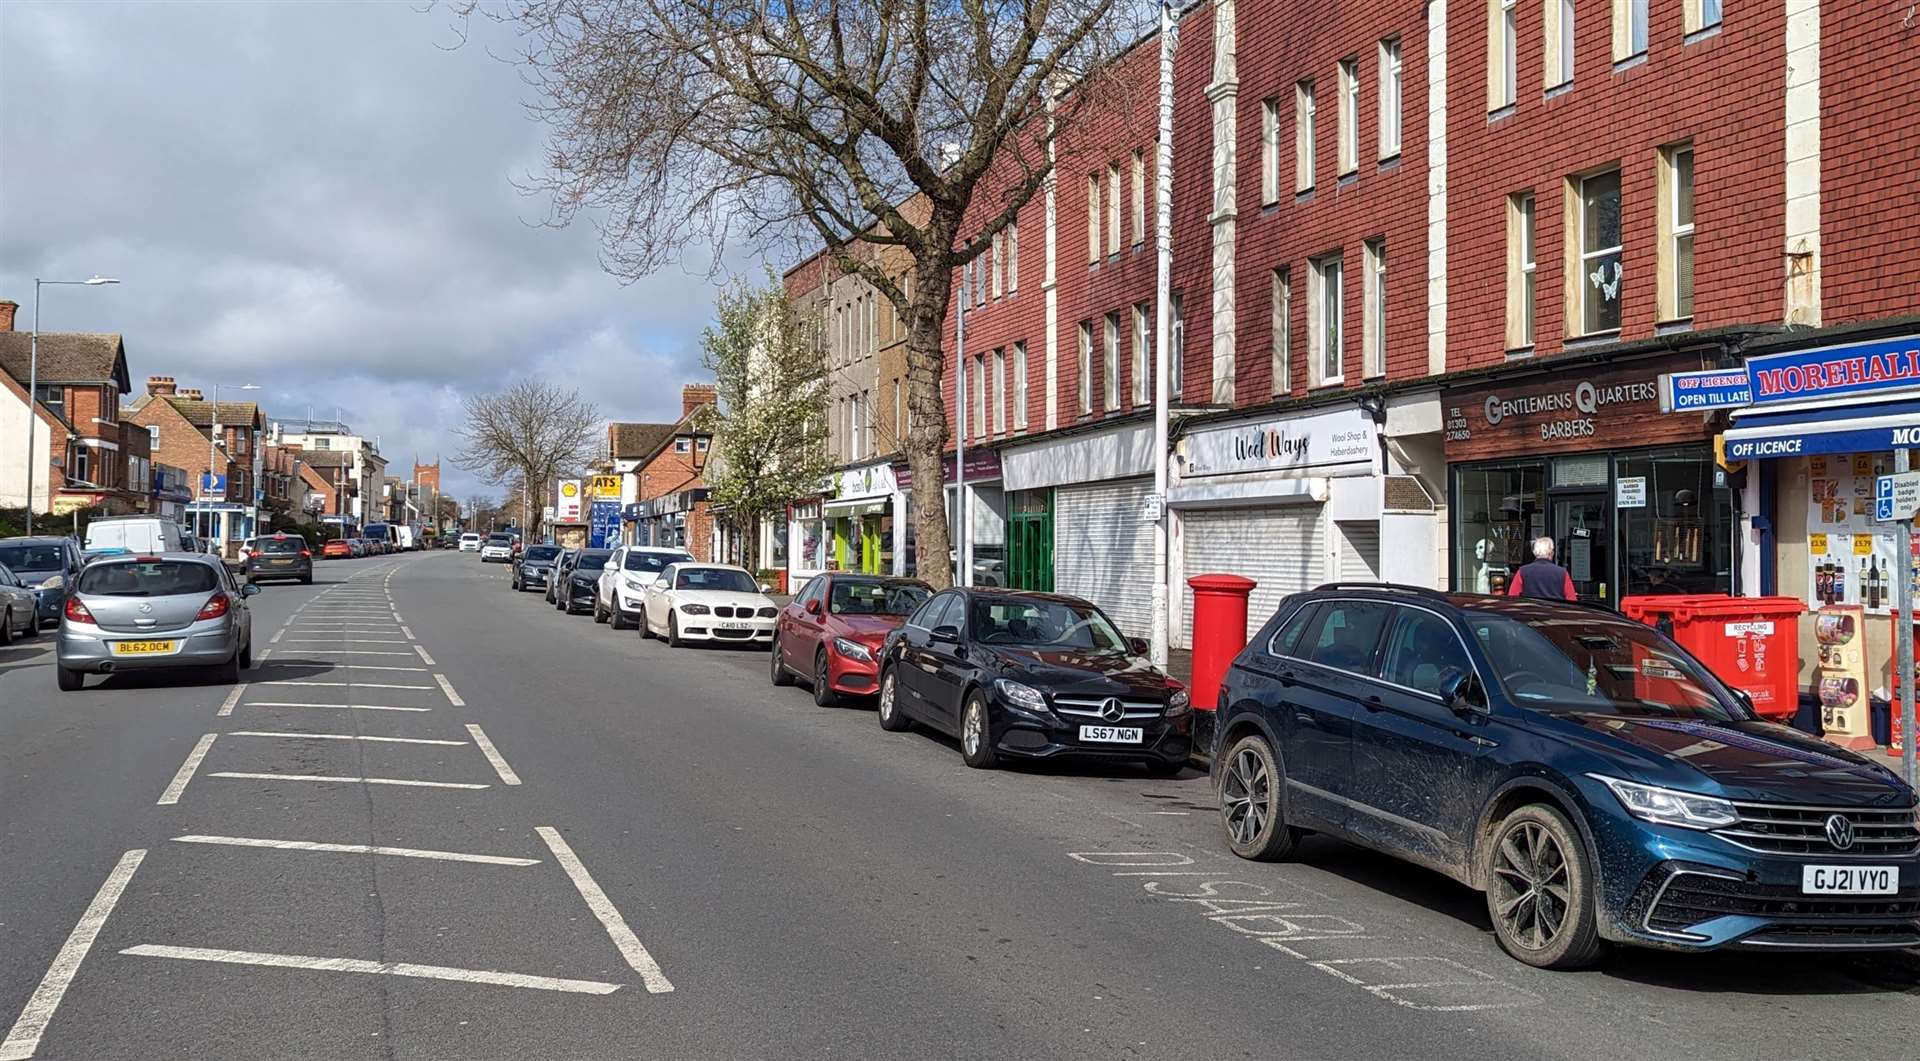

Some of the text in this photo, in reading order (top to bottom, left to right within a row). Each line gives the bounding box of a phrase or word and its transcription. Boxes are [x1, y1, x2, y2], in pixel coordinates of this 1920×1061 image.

[1678, 374, 1749, 390] OFF LICENCE
[1484, 381, 1657, 424] GENTLEMENS QUARTERS
[1679, 390, 1749, 406] OPEN TILL LATE
[1450, 407, 1462, 417] TEL
[1331, 432, 1346, 443] Wool
[1347, 430, 1362, 444] Shop
[1540, 418, 1594, 440] BARBERS
[1235, 429, 1310, 461] Wool Ways
[1732, 439, 1802, 457] OFF LICENCE
[594, 477, 616, 488] ATS
[1894, 480, 1919, 489] Disabled
[1734, 623, 1768, 631] RECYCLING
[1084, 727, 1139, 741] LS67 NGN
[1814, 868, 1889, 891] GJ21 VYO
[1066, 850, 1544, 1013] DISABLED
